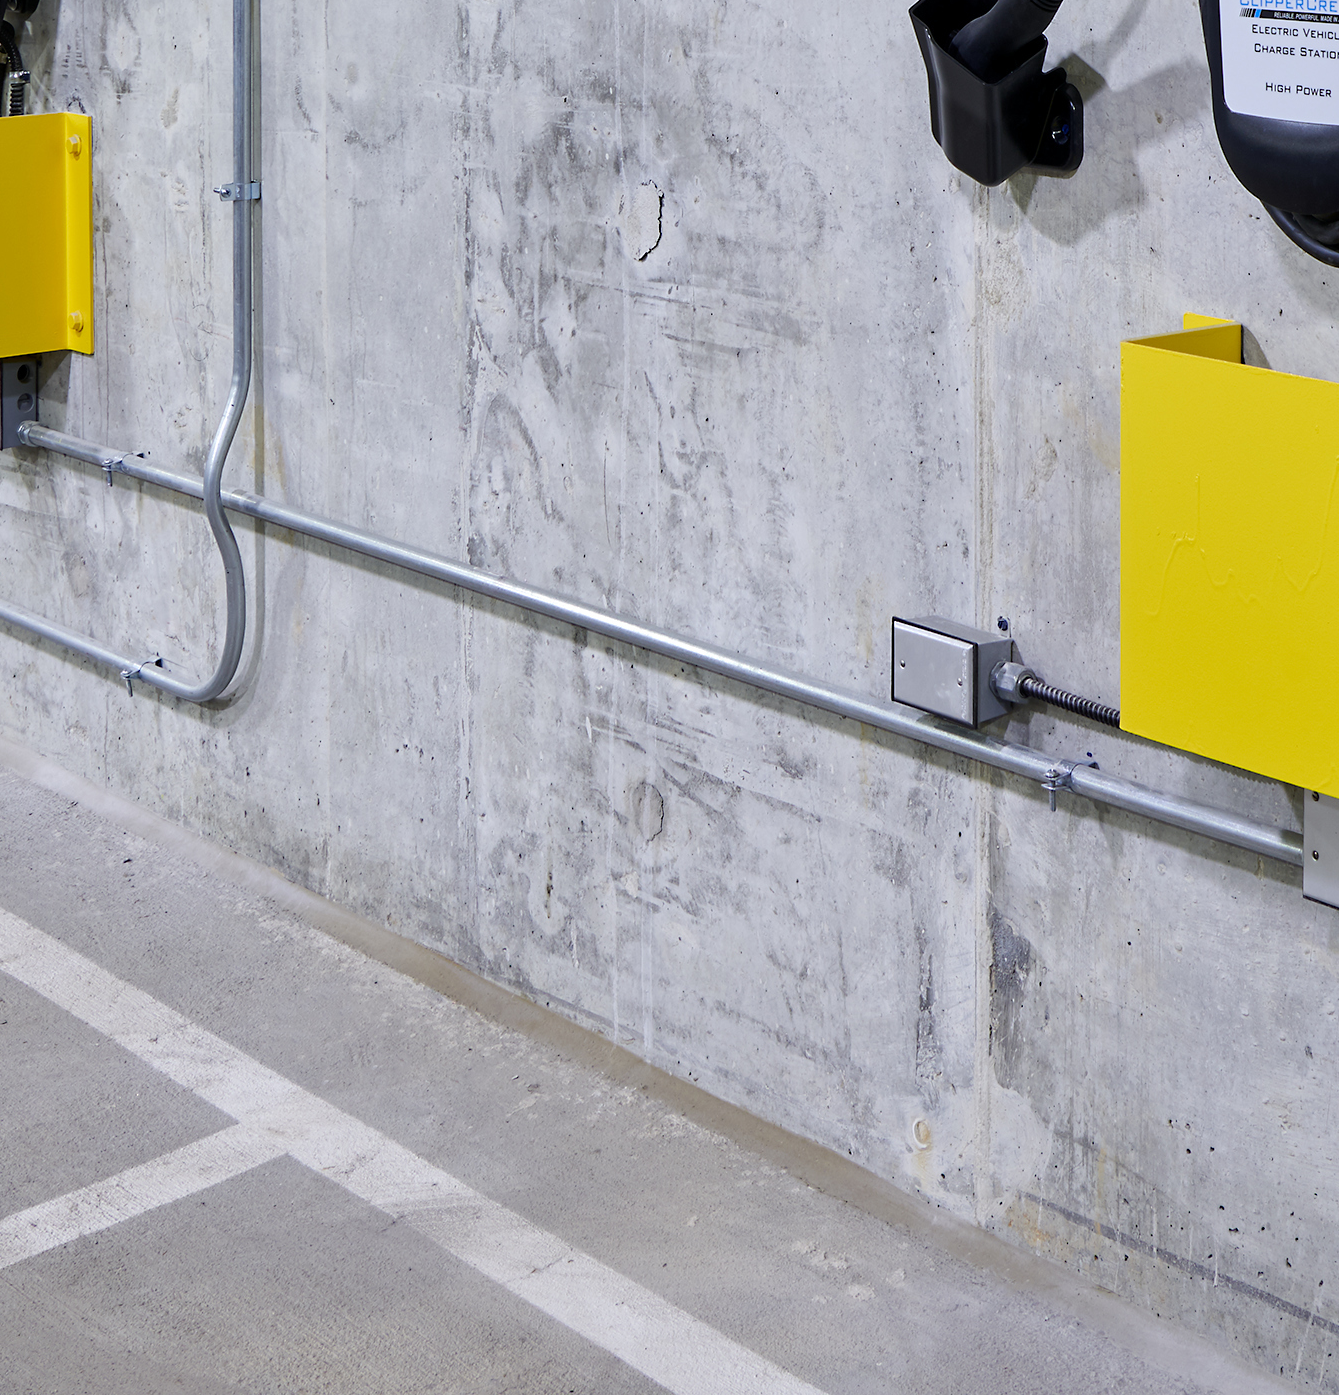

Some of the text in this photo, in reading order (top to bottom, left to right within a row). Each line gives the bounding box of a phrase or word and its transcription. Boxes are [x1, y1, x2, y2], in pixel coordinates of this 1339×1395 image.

[1320, 15, 1333, 23] MADE
[1251, 24, 1299, 37] ELECTRIC
[1253, 43, 1296, 56] CHARGE
[1265, 82, 1332, 98] HIGH POWER
